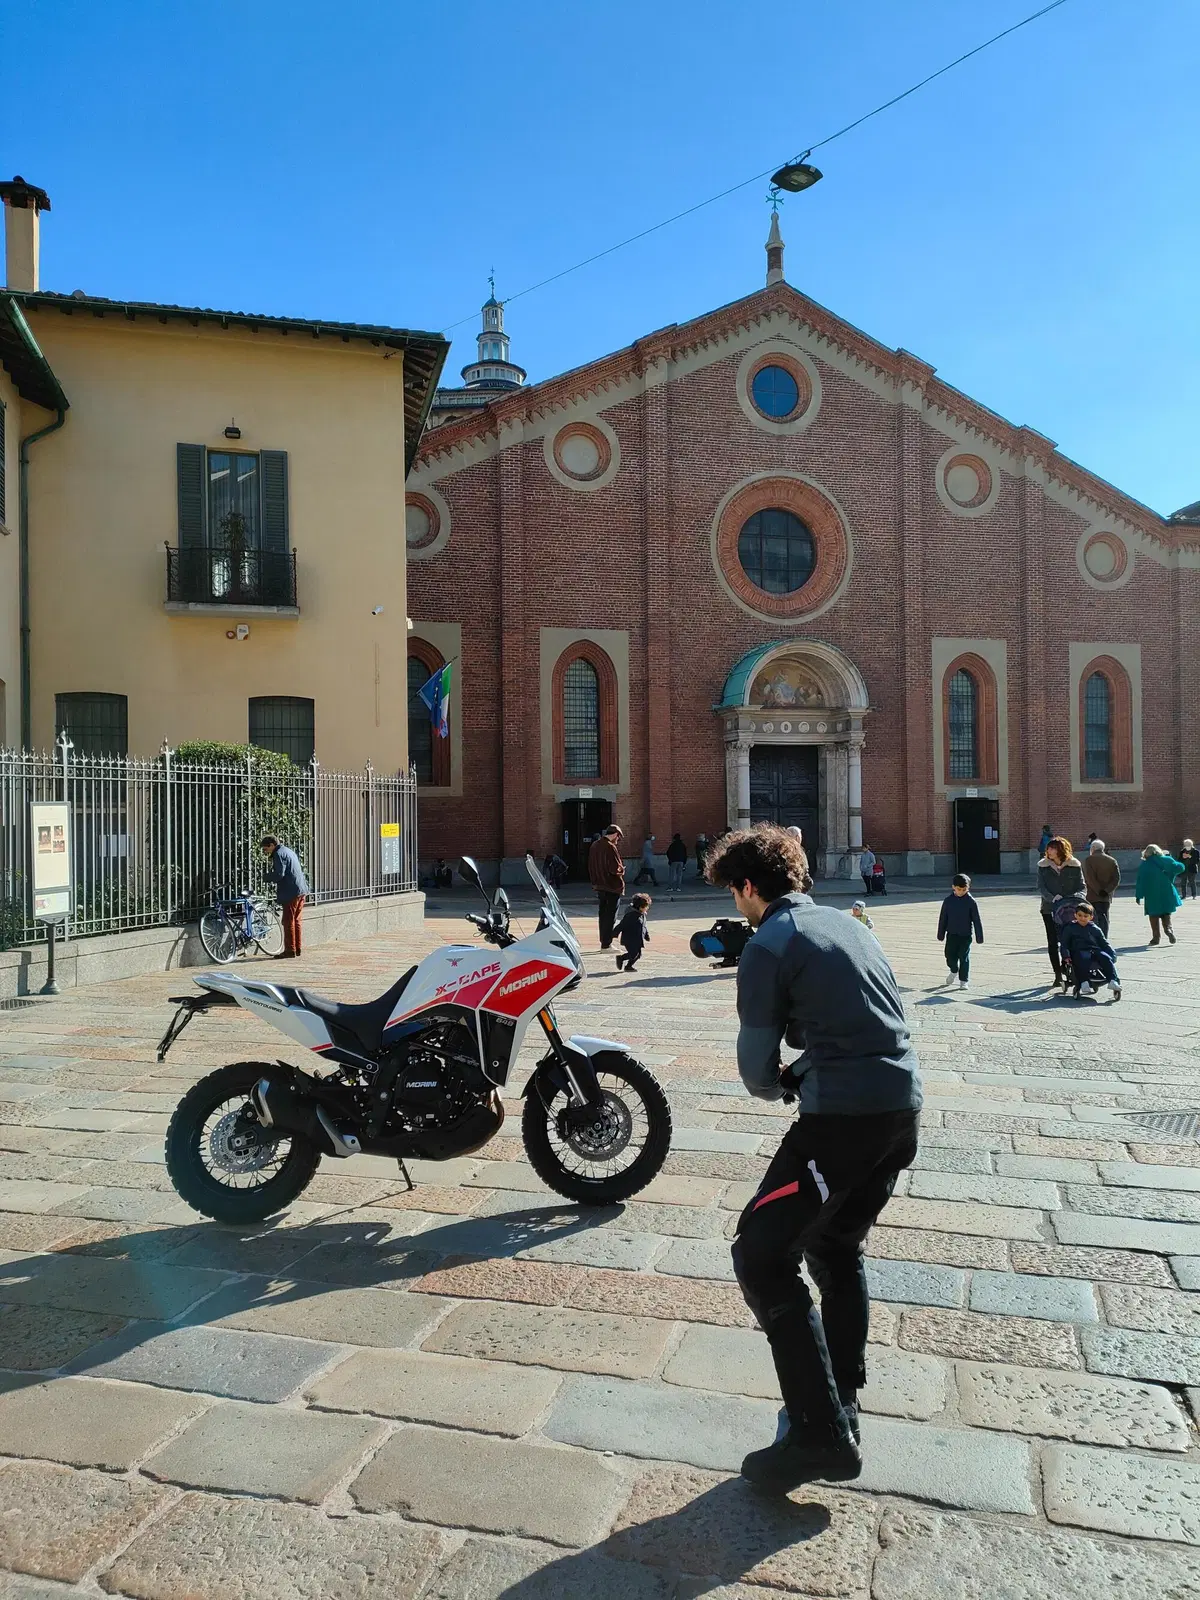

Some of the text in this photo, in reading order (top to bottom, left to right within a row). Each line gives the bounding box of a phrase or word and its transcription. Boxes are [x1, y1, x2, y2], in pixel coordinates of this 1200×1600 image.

[434, 961, 501, 997] X-CAPE
[499, 968, 548, 997] MORINI
[405, 1081, 437, 1089] MORINI
